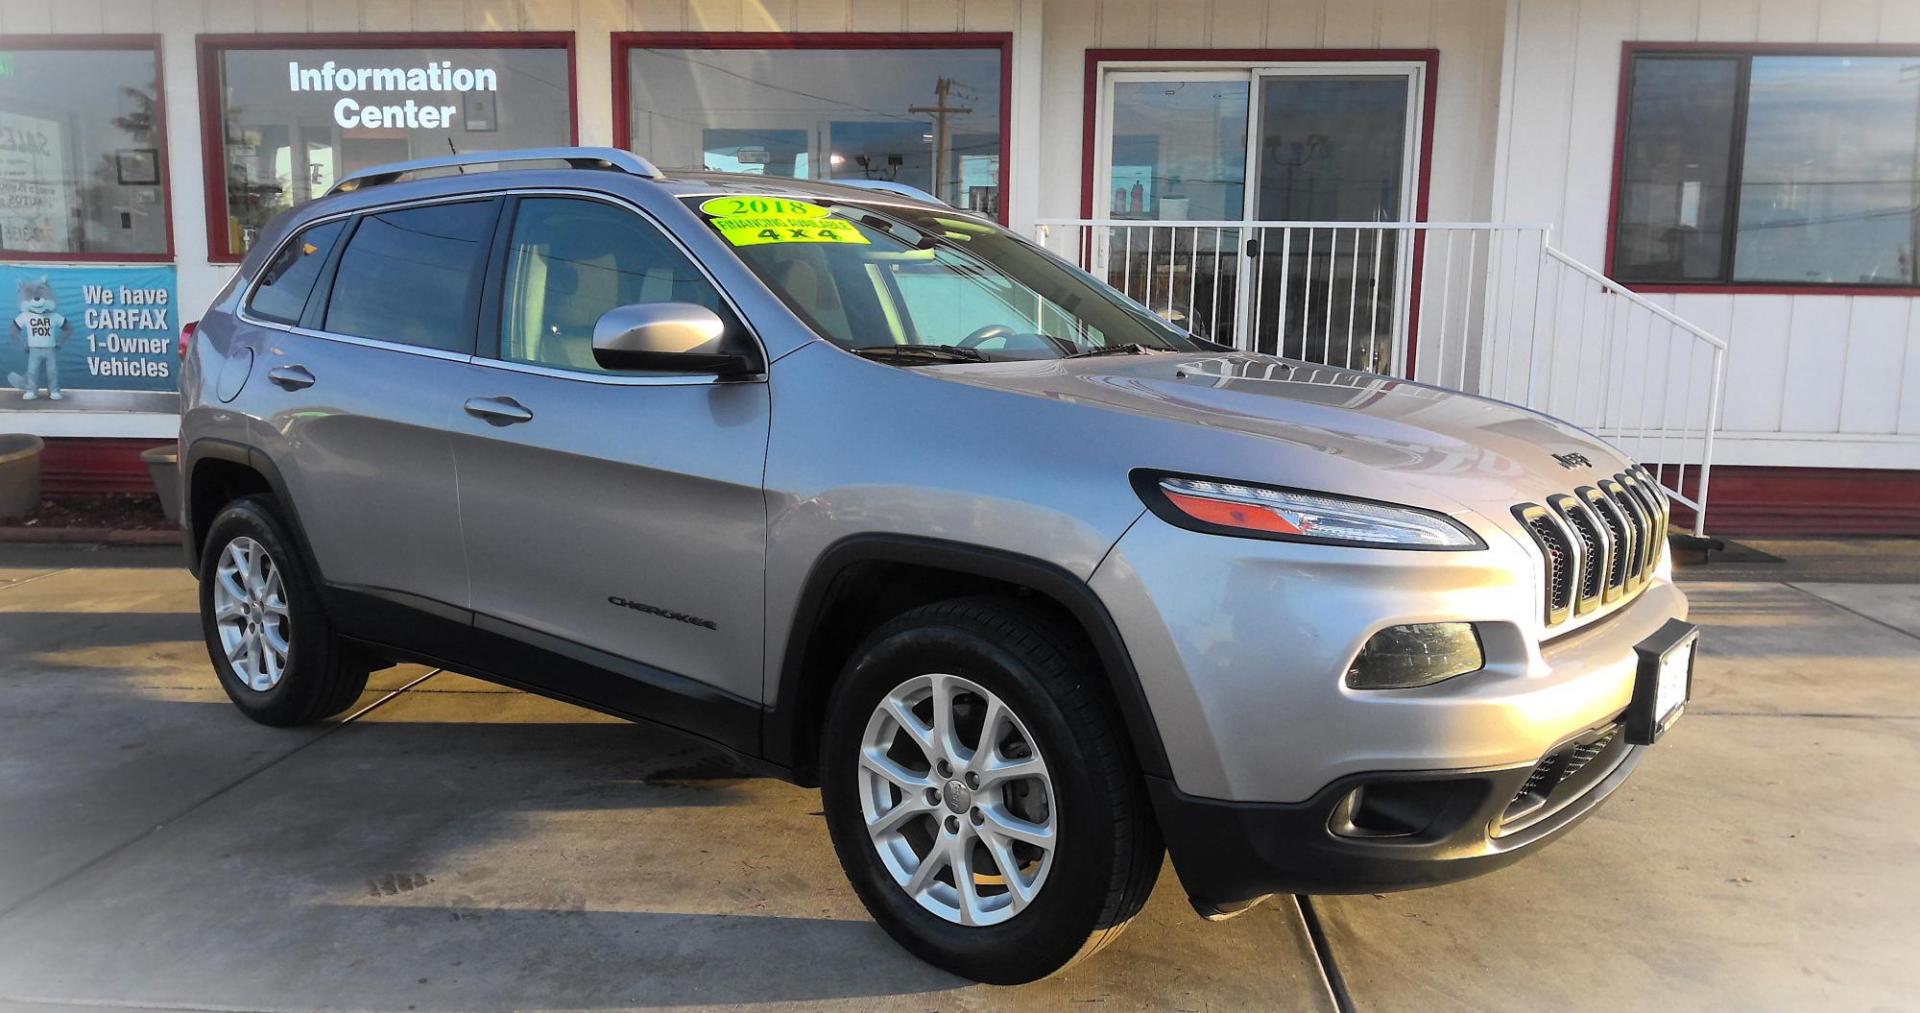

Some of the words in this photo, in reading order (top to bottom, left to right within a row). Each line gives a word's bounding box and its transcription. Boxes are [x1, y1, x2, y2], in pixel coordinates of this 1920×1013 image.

[289, 61, 497, 92] Information
[334, 98, 457, 128] Center
[729, 200, 807, 214] 2018
[716, 218, 787, 230] FINANCING
[83, 285, 113, 305] We
[120, 285, 168, 305] have
[30, 318, 50, 327] CAR
[84, 309, 168, 330] CARFAX
[32, 327, 51, 337] FOX
[87, 333, 170, 354] 1-Owner
[87, 357, 169, 377] Vehicles
[607, 596, 718, 631] CHEROKEE
